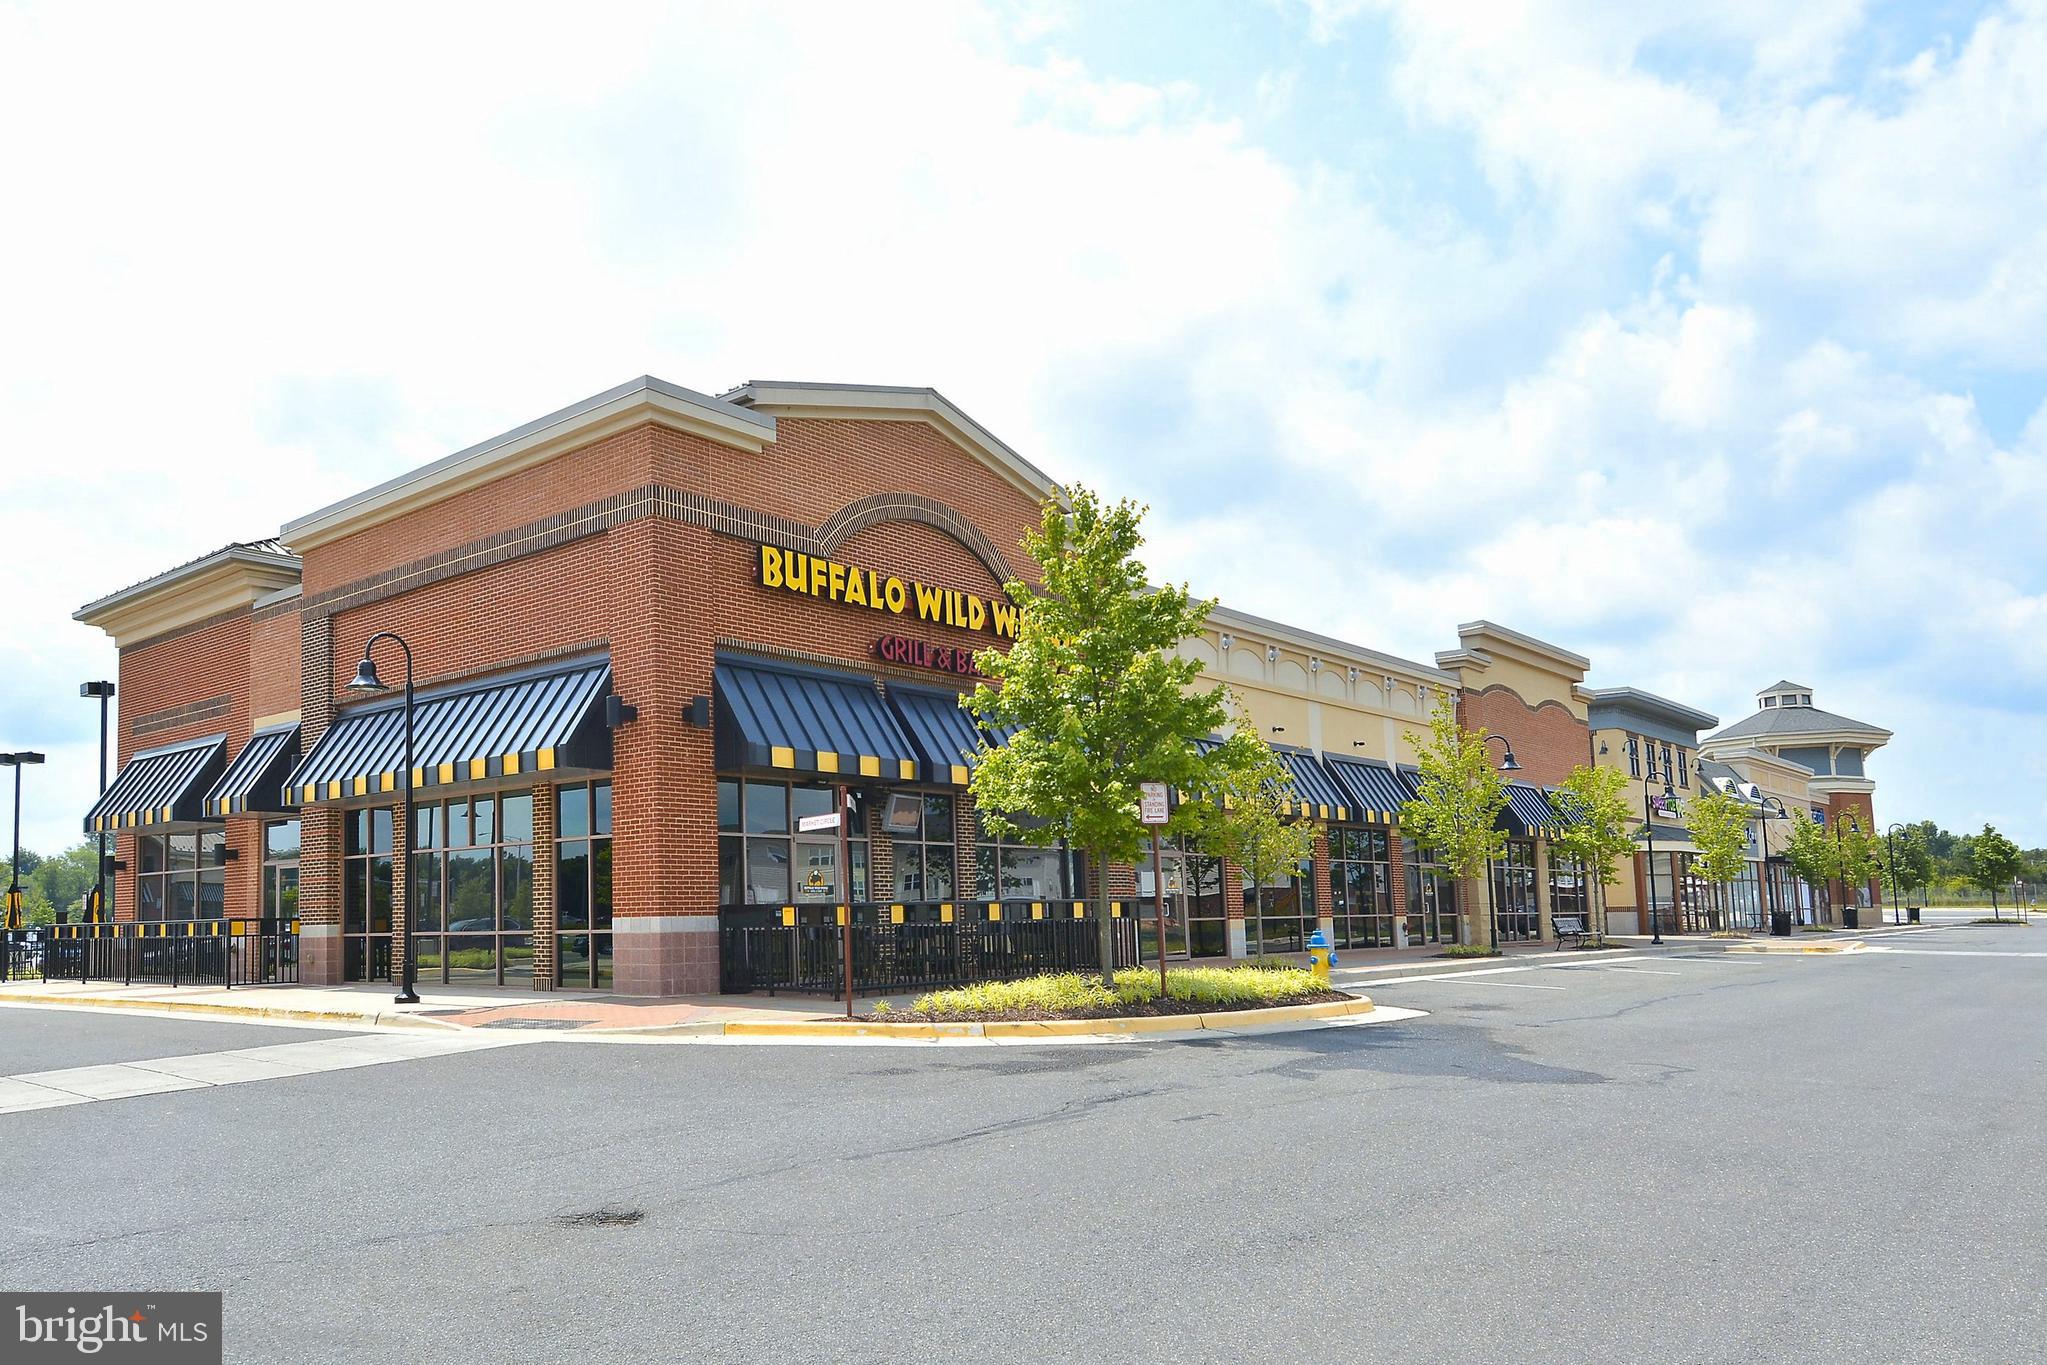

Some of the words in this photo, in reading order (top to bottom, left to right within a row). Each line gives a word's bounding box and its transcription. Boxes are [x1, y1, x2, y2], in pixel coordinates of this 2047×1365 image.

[761, 545, 906, 614] BUFFALO
[913, 582, 986, 631] WILD
[880, 635, 932, 668] GRILL
[936, 647, 952, 669] &
[956, 650, 984, 677] BA
